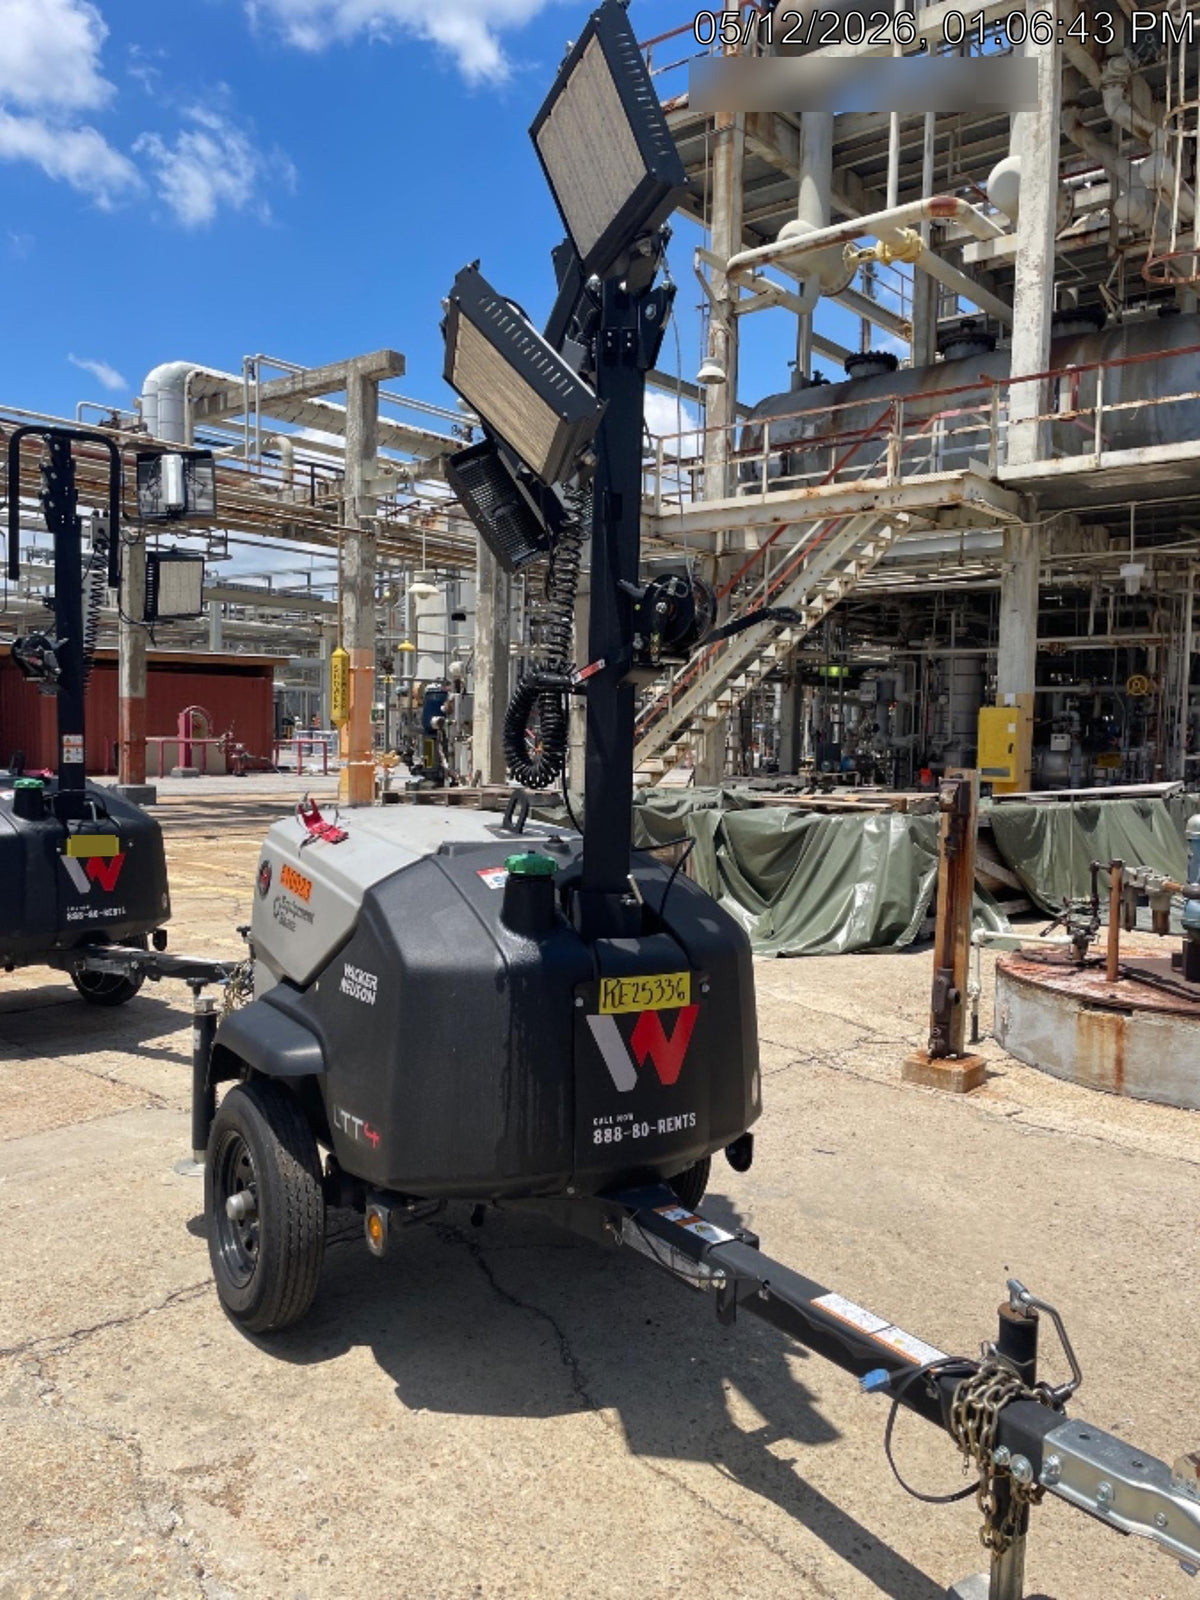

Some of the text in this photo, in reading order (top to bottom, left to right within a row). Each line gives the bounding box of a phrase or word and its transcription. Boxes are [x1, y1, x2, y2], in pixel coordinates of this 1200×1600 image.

[339, 977, 376, 1006] NEUSON
[344, 962, 378, 991] WACKER
[602, 976, 687, 1009] RE25336
[593, 1112, 696, 1144] 888-80-RENTS
